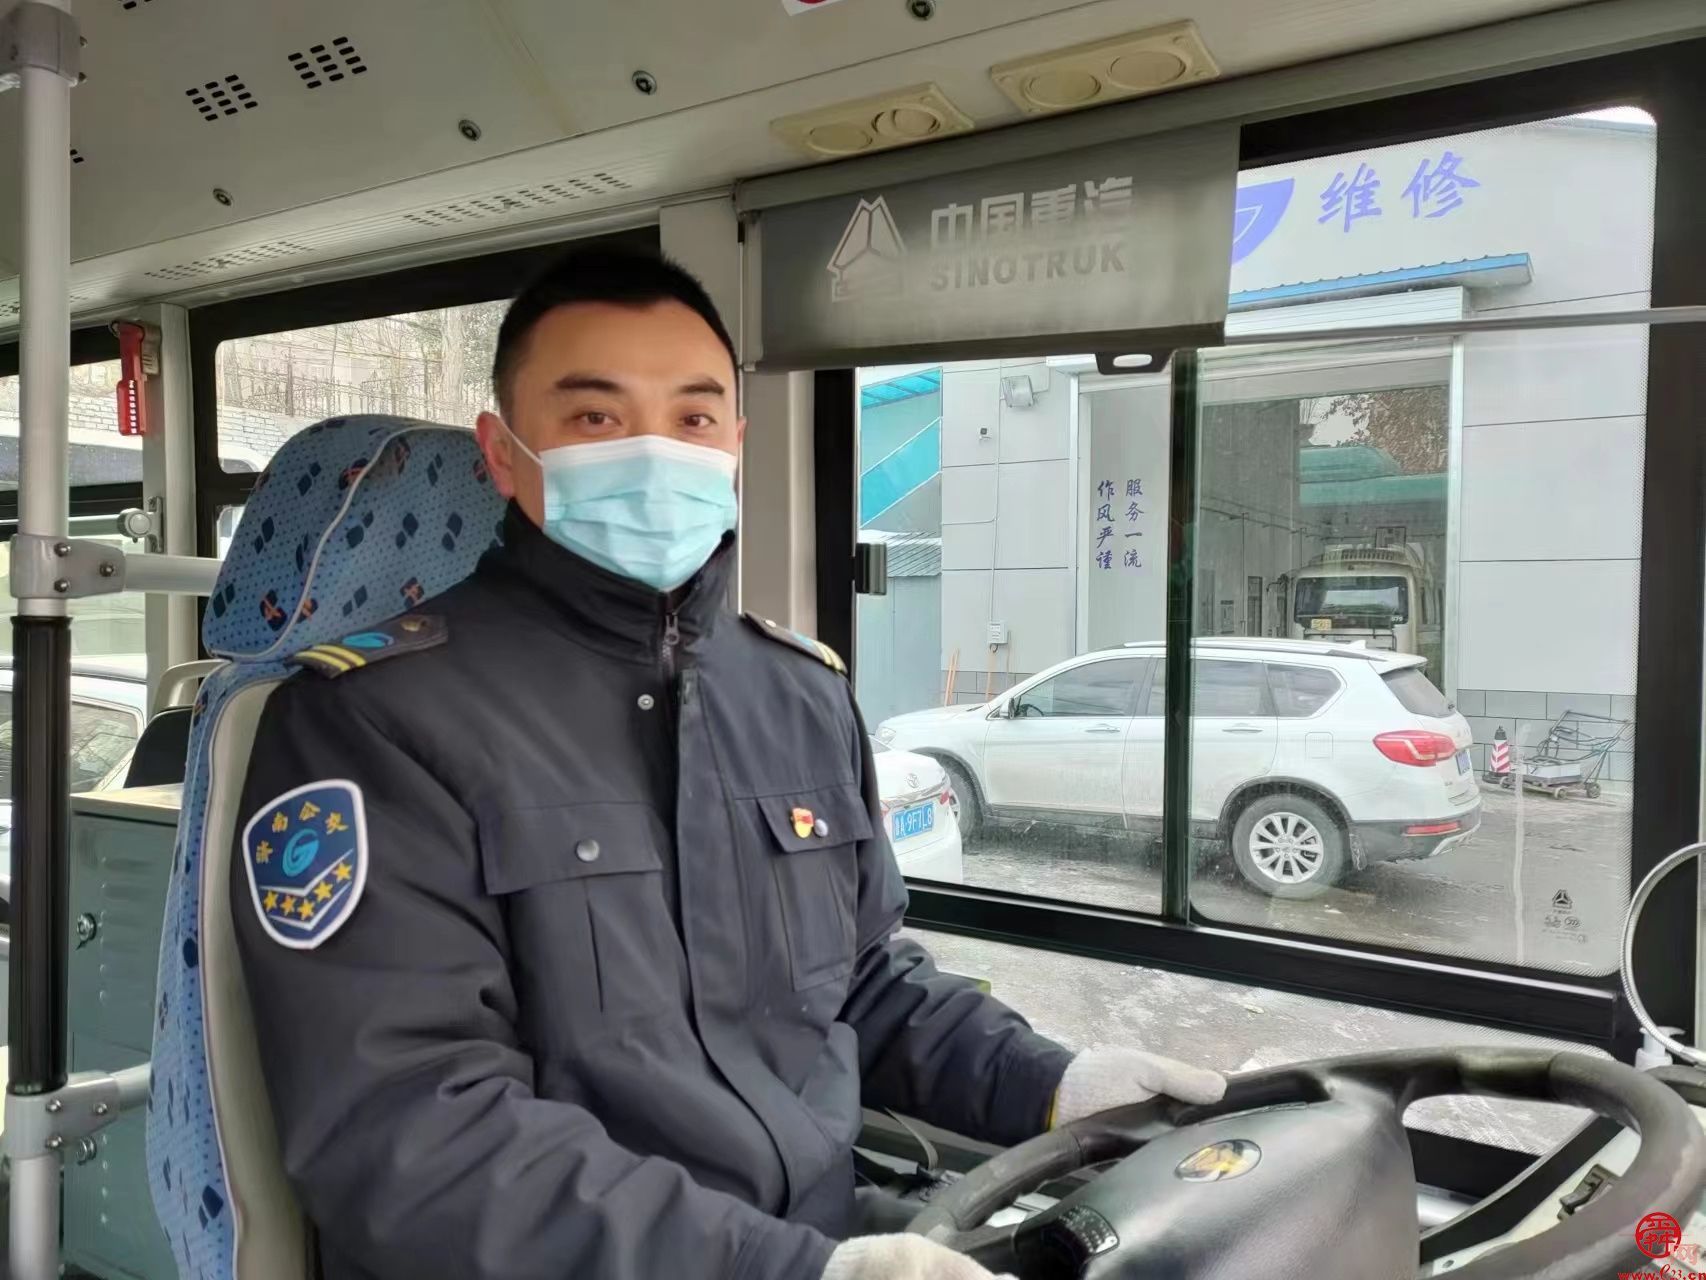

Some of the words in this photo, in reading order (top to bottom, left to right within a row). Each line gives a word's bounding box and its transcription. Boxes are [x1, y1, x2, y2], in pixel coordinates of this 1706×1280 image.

[1318, 151, 1481, 233] 维修
[930, 241, 1125, 292] SINOTRUK
[1096, 479, 1116, 570] 作风严谨
[1124, 478, 1145, 568] 服务一流
